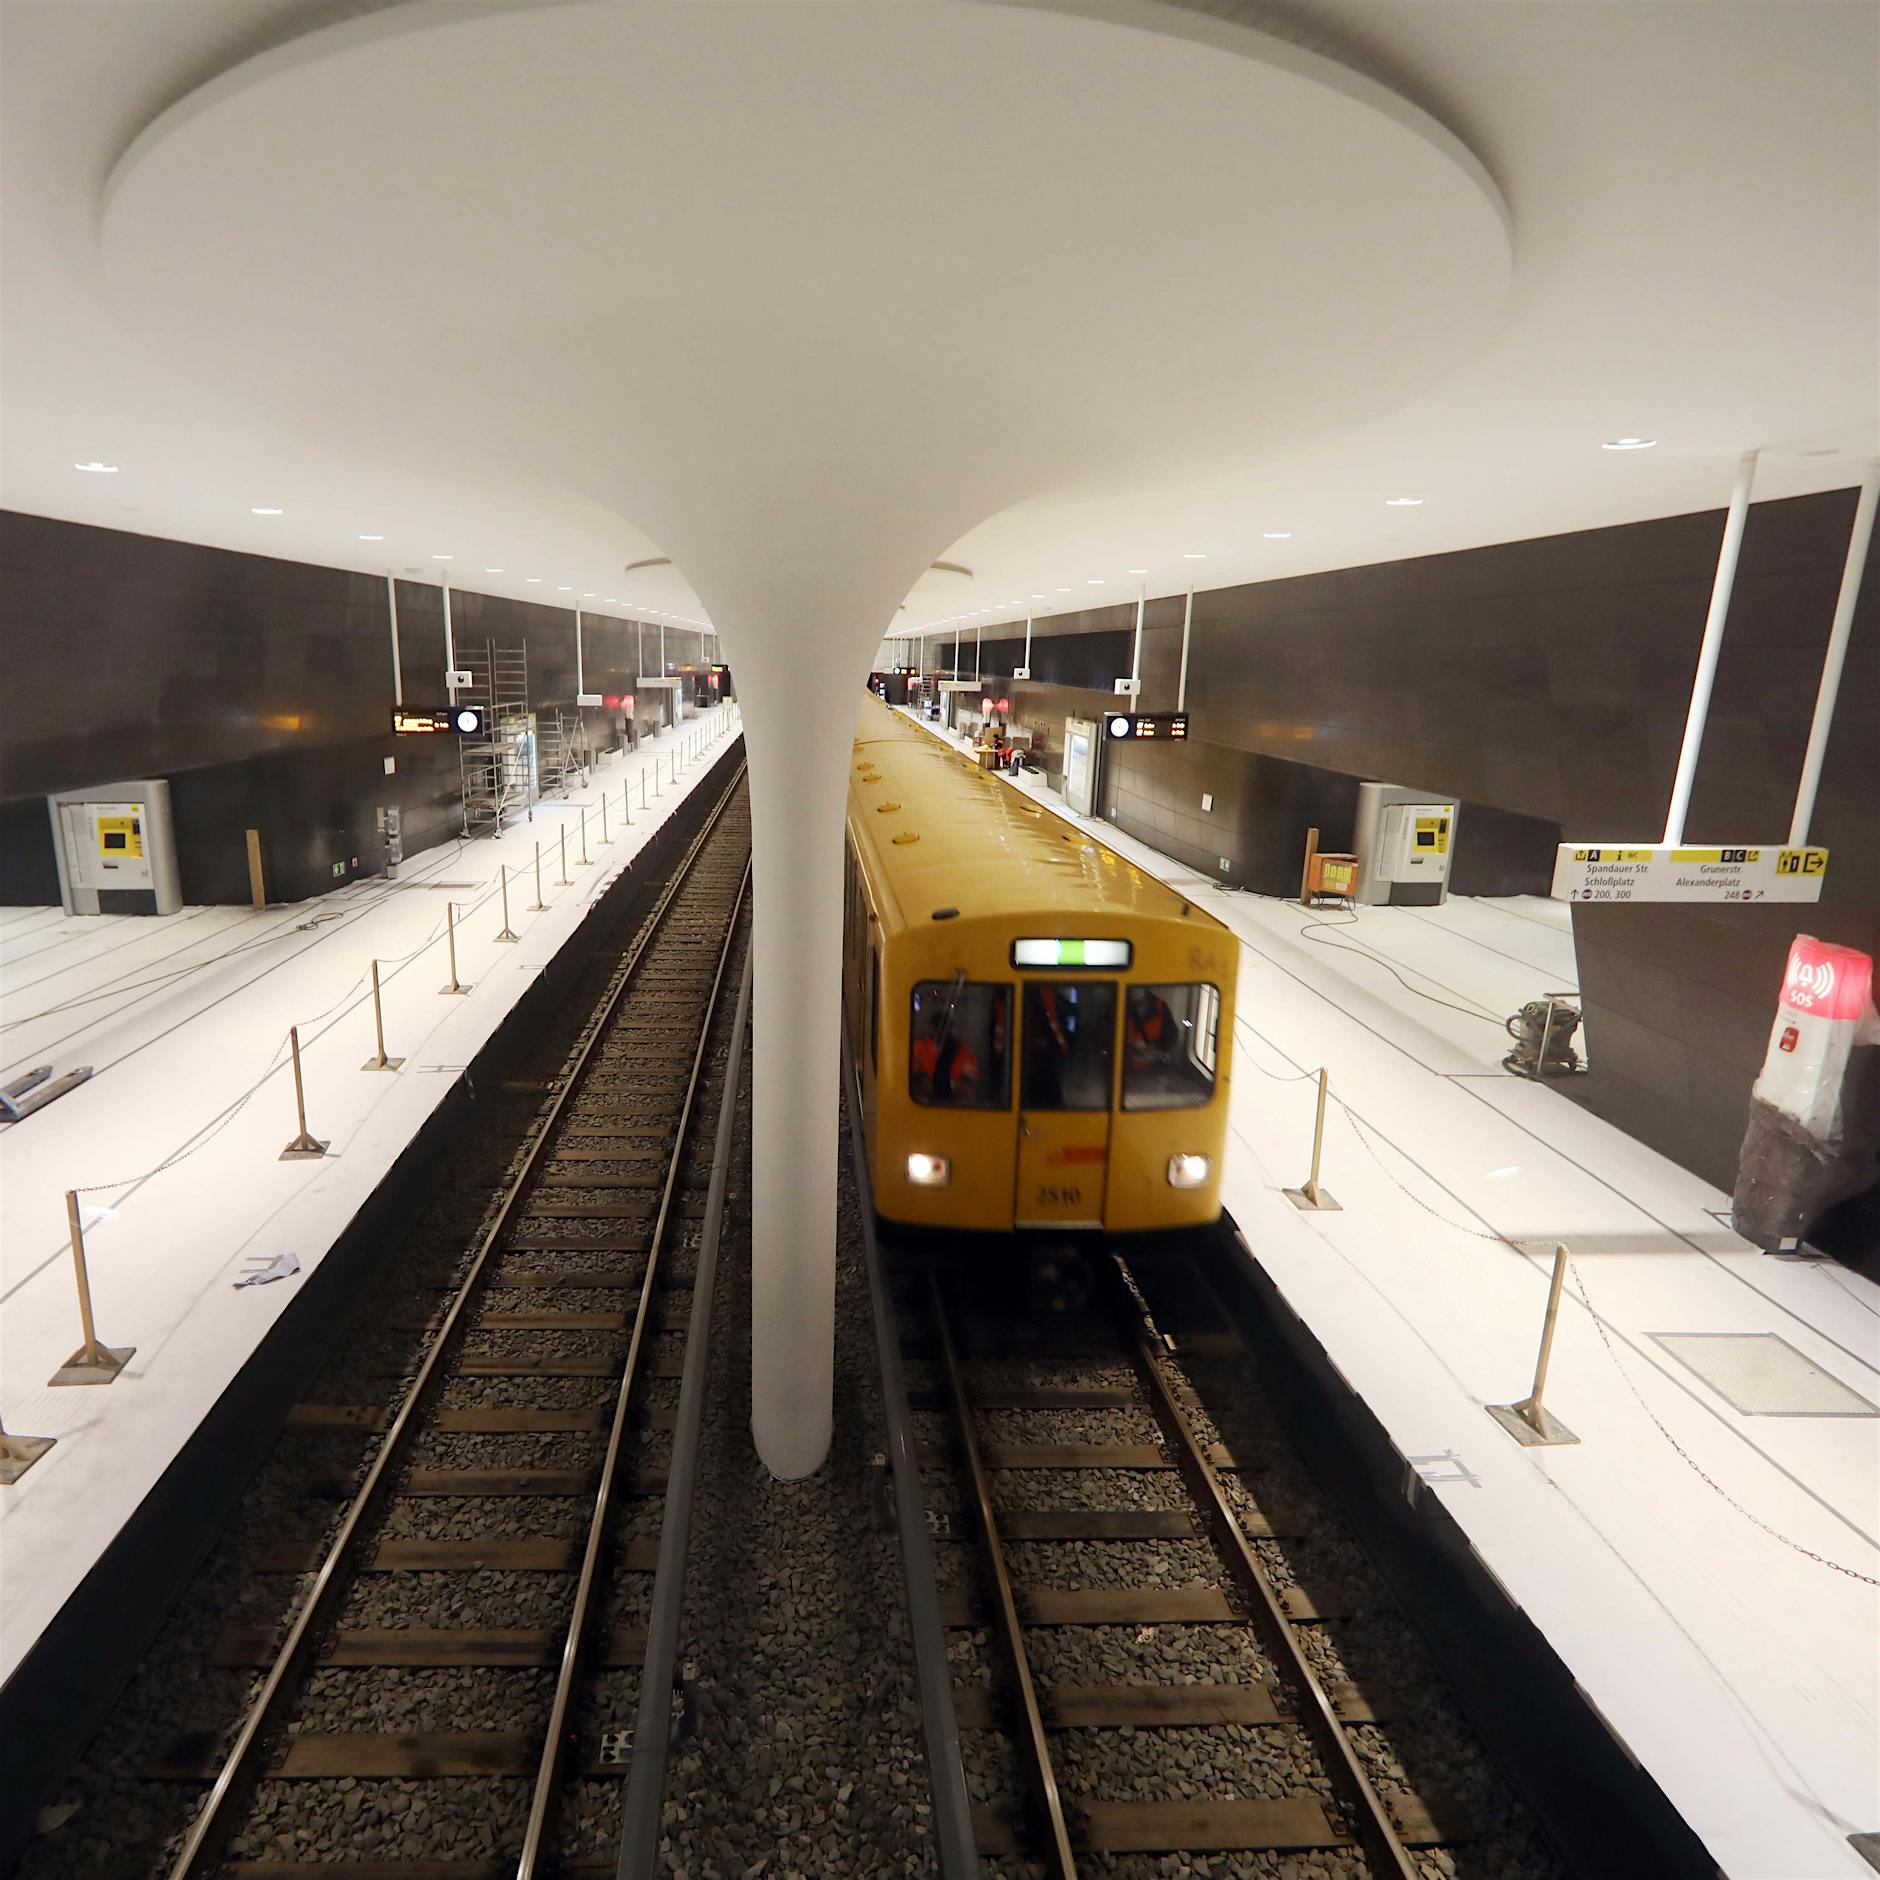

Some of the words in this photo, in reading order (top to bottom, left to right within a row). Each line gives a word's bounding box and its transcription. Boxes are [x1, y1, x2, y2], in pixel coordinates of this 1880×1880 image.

[1589, 849, 1599, 860] A
[1735, 850, 1744, 860] C
[1586, 864, 1633, 875] Spandauer
[1584, 876, 1636, 888] Schloßplatz
[1675, 877, 1741, 888] Alexanderplatz
[1594, 889, 1612, 900] 200,
[1615, 889, 1632, 899] 300
[1724, 890, 1741, 900] 248
[1790, 990, 1813, 1008] SOS
